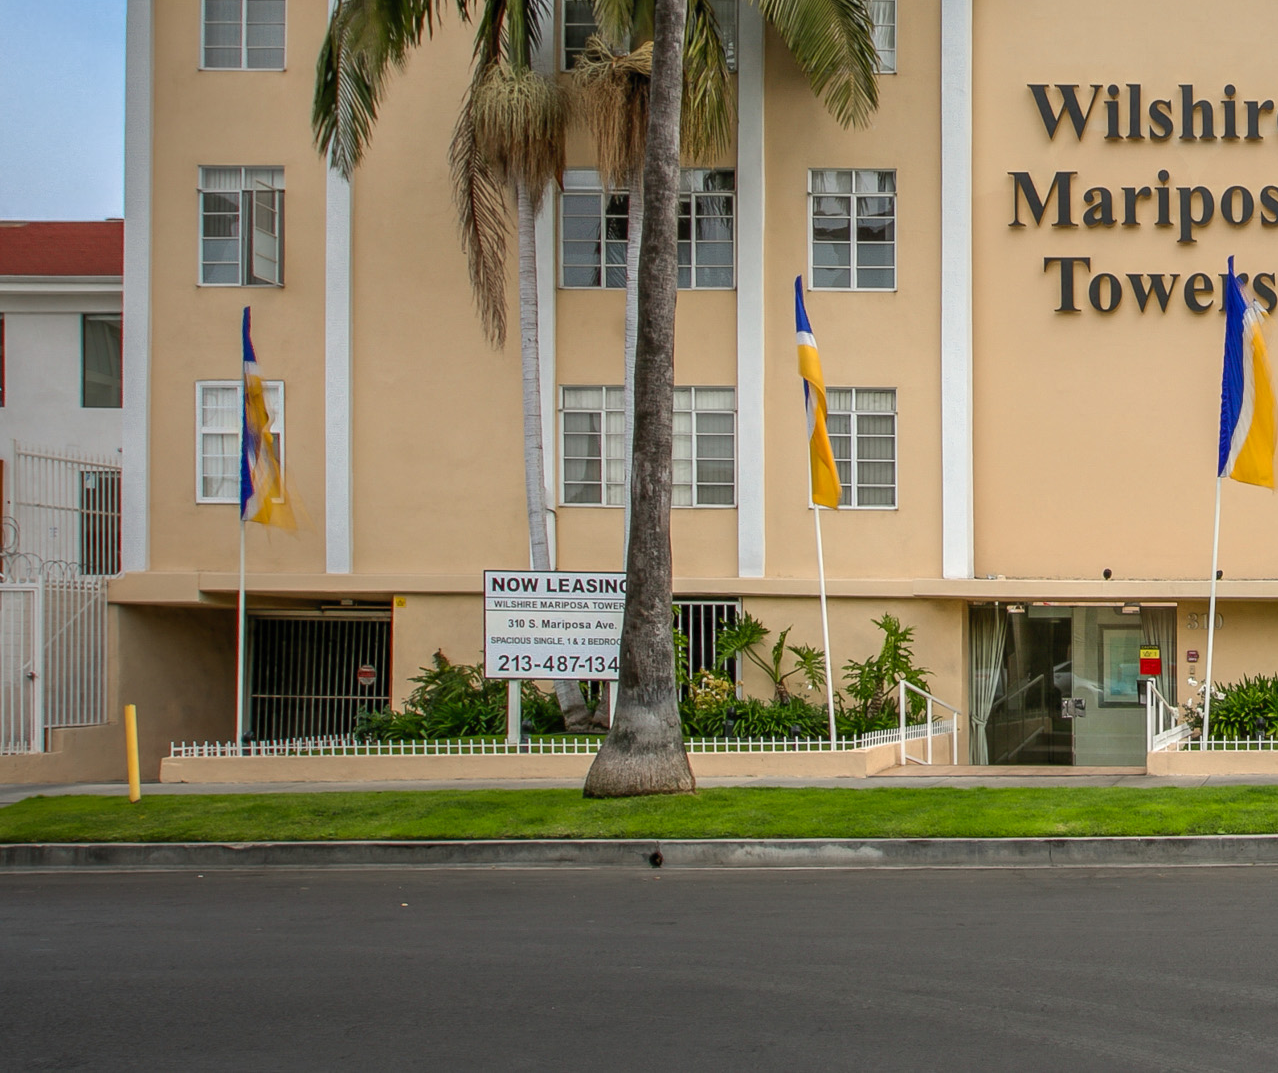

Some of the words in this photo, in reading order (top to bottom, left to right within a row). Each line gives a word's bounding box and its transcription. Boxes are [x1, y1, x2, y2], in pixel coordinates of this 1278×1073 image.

[1043, 257, 1278, 314] Towers
[492, 577, 539, 592] NOW
[494, 600, 538, 609] WILSHIRE
[540, 601, 590, 610] MARIPOSA
[593, 602, 626, 610] TOWER
[508, 618, 525, 628] 310
[528, 619, 539, 628] S.
[541, 619, 592, 630] Mariposa
[595, 620, 617, 630] Ave.
[1187, 612, 1224, 631] 310
[490, 636, 532, 645] SPACIOUS
[533, 637, 565, 646] SINGLE,
[588, 638, 621, 646] BEDROO
[497, 654, 620, 673] 213-487-134
